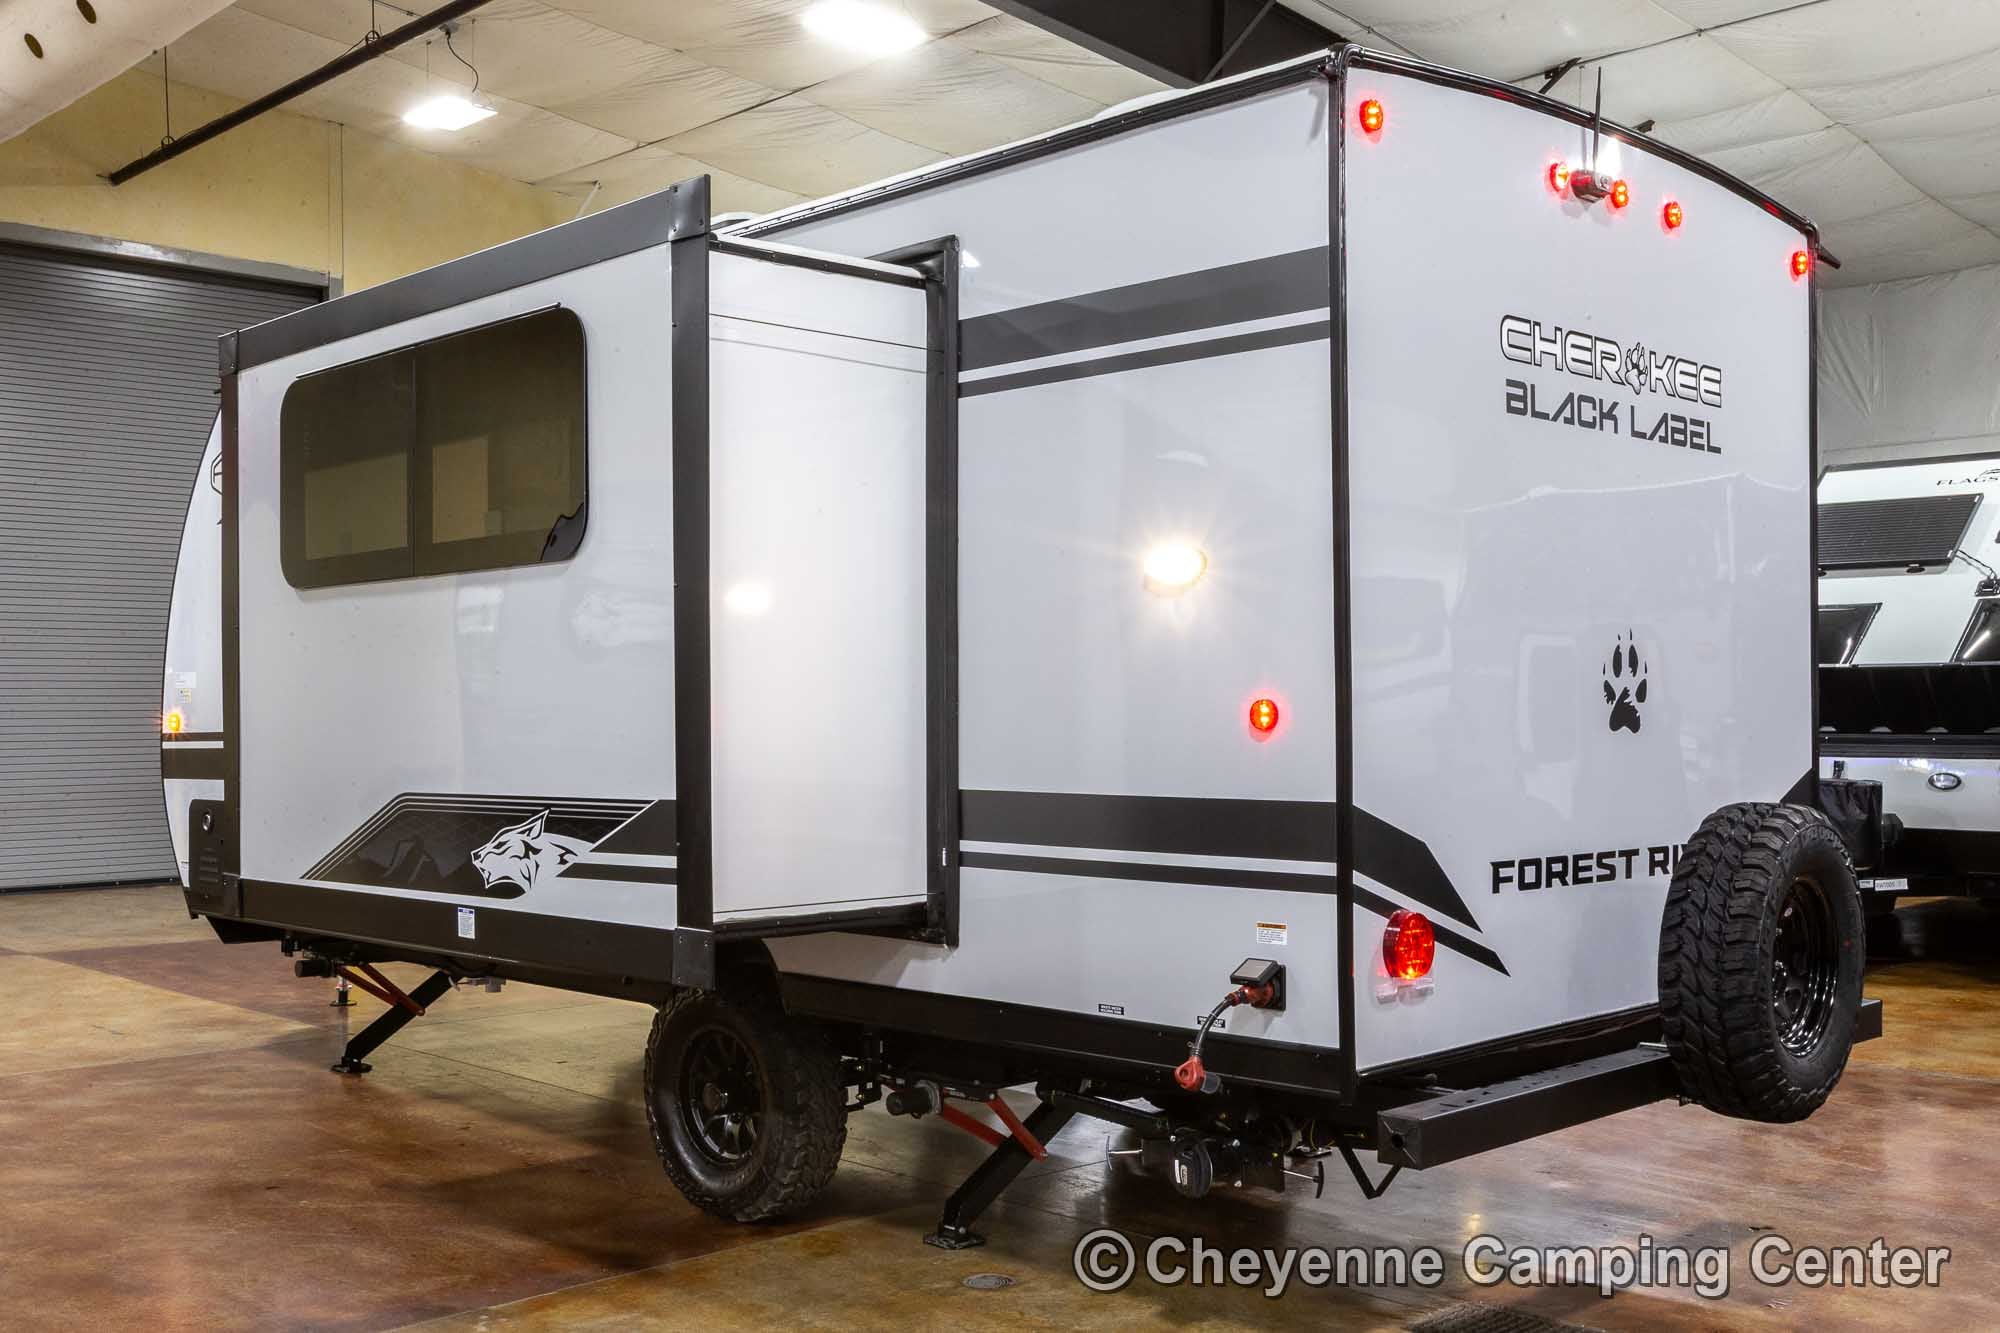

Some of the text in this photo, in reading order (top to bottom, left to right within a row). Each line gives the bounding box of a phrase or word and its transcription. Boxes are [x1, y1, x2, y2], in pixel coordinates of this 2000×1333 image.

[1506, 378, 1722, 455] BLACK LABEL
[1489, 848, 1640, 894] FOREST
